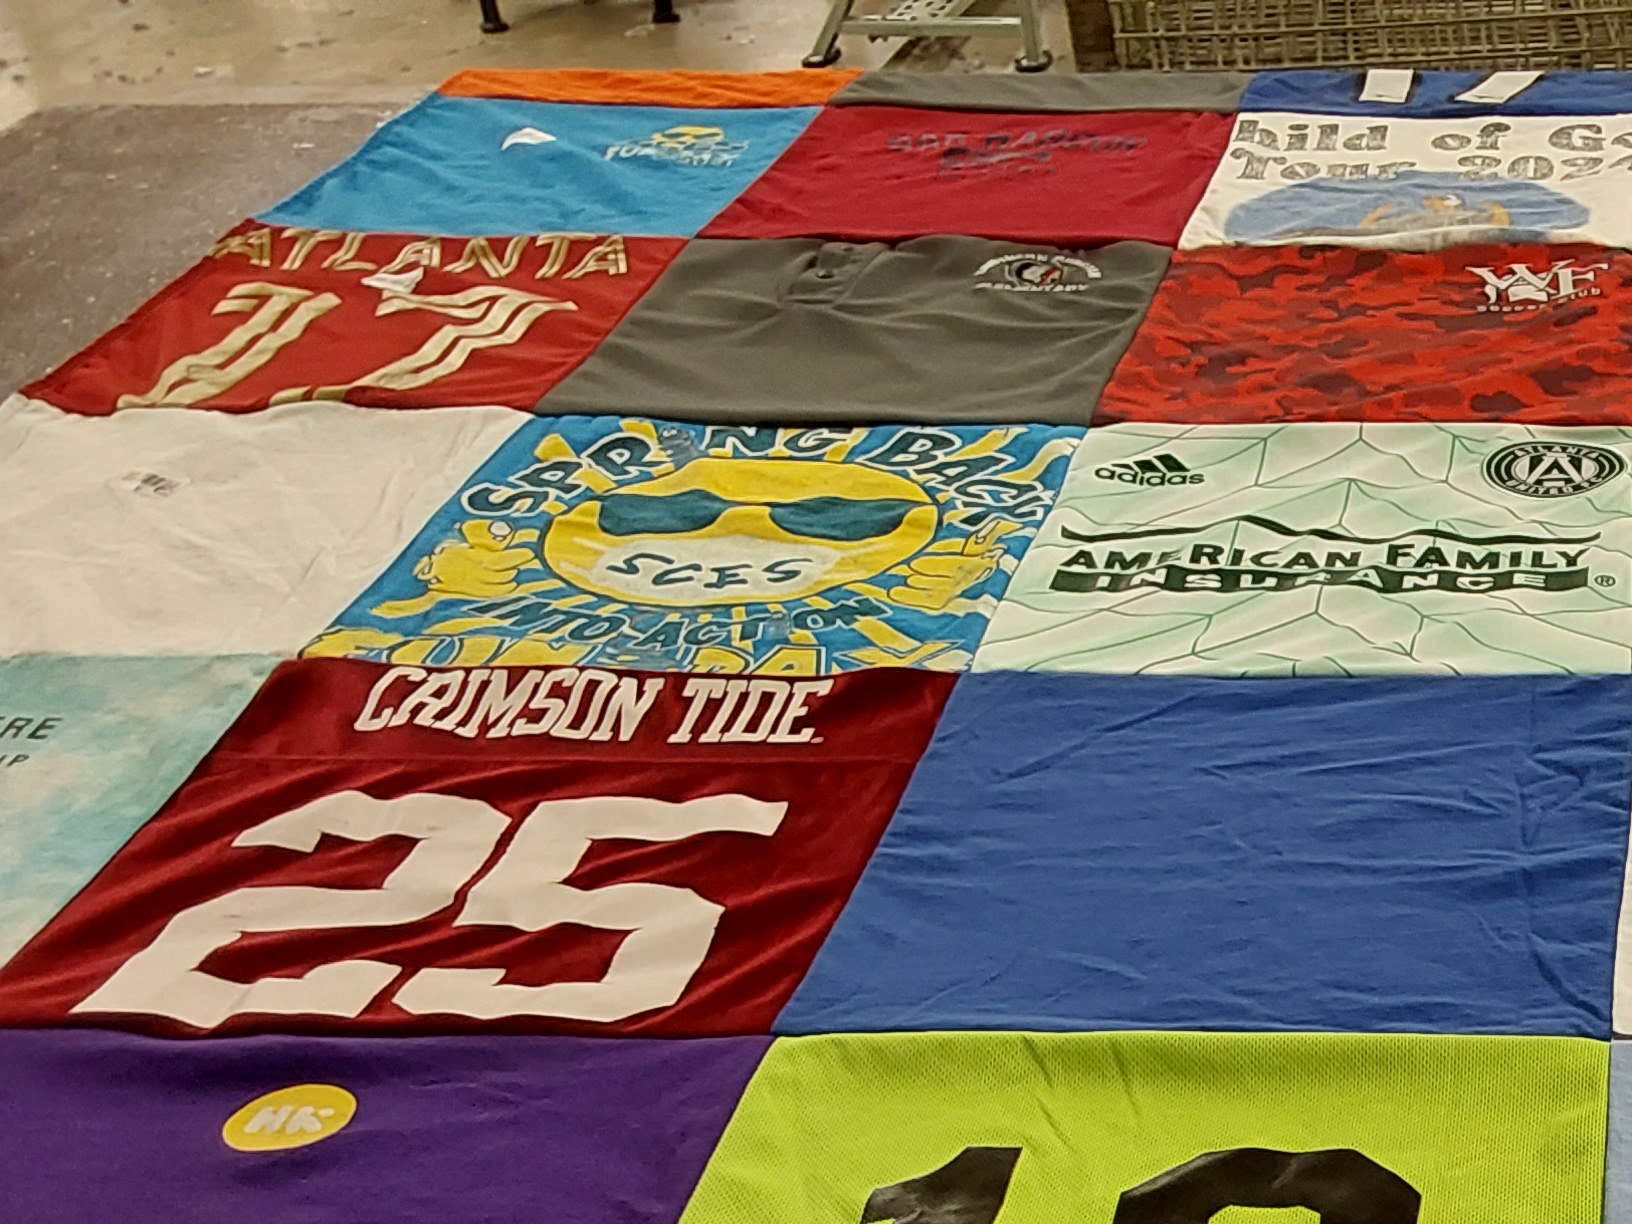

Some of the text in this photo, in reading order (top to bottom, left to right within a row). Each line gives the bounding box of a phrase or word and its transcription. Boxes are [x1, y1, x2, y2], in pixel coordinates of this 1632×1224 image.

[1430, 121, 1512, 151] of
[209, 227, 628, 279] ATLANTA
[1513, 445, 1600, 459] ATLANTA
[853, 427, 1056, 530] BACK
[1094, 465, 1206, 487] adidas
[1505, 478, 1574, 495] UNITED
[605, 550, 815, 590] SCES
[1059, 542, 1592, 570] AMERICAN FAMILY
[354, 667, 836, 744] CRIMSON TIDE
[0, 715, 64, 739] RE
[66, 790, 790, 1029] 25
[243, 1103, 336, 1135] HK
